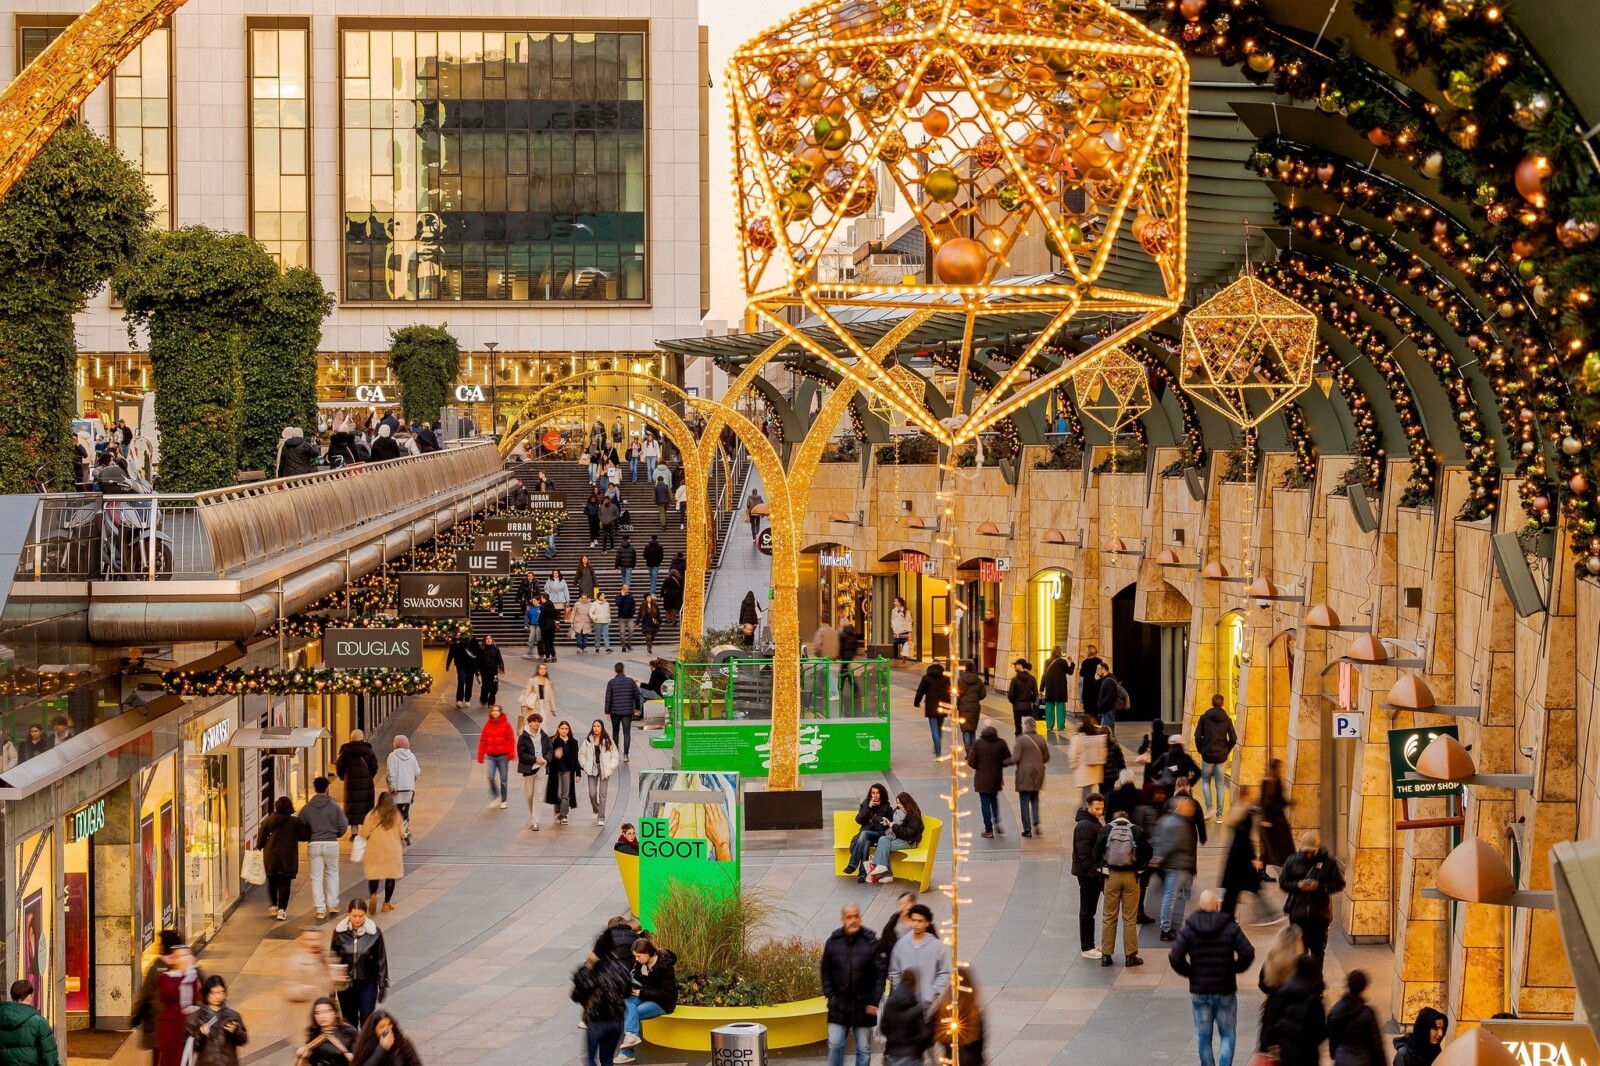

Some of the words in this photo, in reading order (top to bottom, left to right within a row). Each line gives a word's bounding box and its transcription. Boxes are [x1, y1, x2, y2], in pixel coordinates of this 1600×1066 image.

[355, 385, 386, 402] C&A
[455, 385, 485, 402] C&A
[507, 522, 532, 531] URBAN
[469, 556, 497, 569] WE
[997, 559, 1005, 570] P
[403, 598, 463, 608] SWAROVSKI
[337, 641, 410, 656] DOUGLAS
[1337, 717, 1349, 736] P
[1397, 785, 1413, 793] THE
[1414, 783, 1436, 792] BODY
[1437, 782, 1460, 790] SHOP
[641, 821, 666, 839] DE
[641, 840, 705, 859] GOOT
[714, 1048, 753, 1059] KOOP
